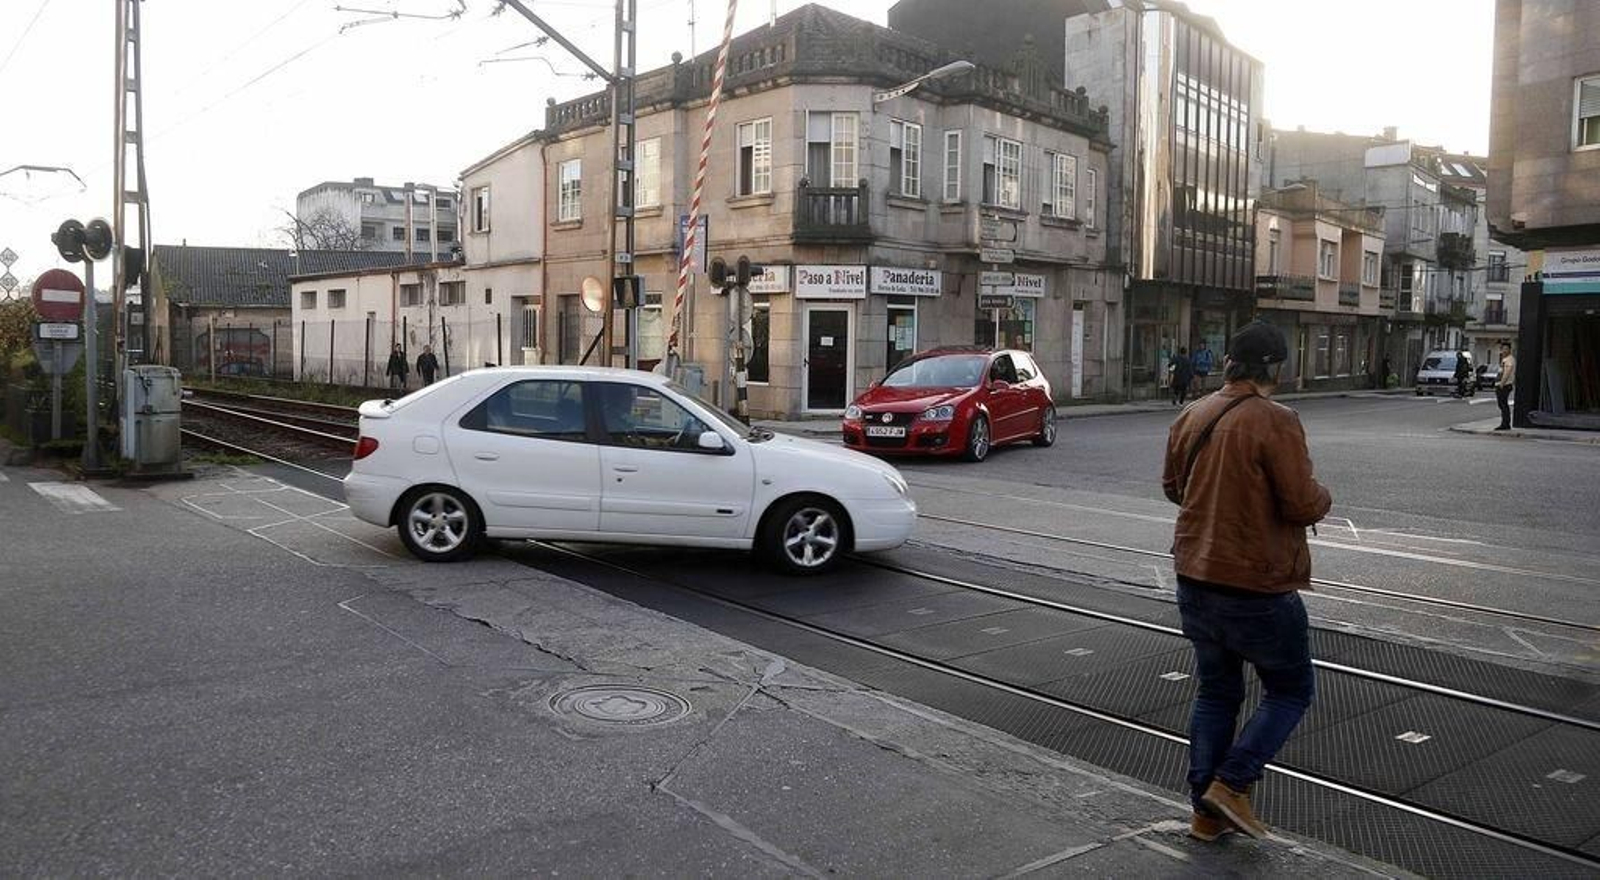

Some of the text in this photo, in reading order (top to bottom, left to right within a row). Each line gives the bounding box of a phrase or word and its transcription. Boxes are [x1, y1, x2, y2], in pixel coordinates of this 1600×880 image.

[799, 269, 864, 285] Paso a Nivel
[1017, 275, 1042, 288] Nivel
